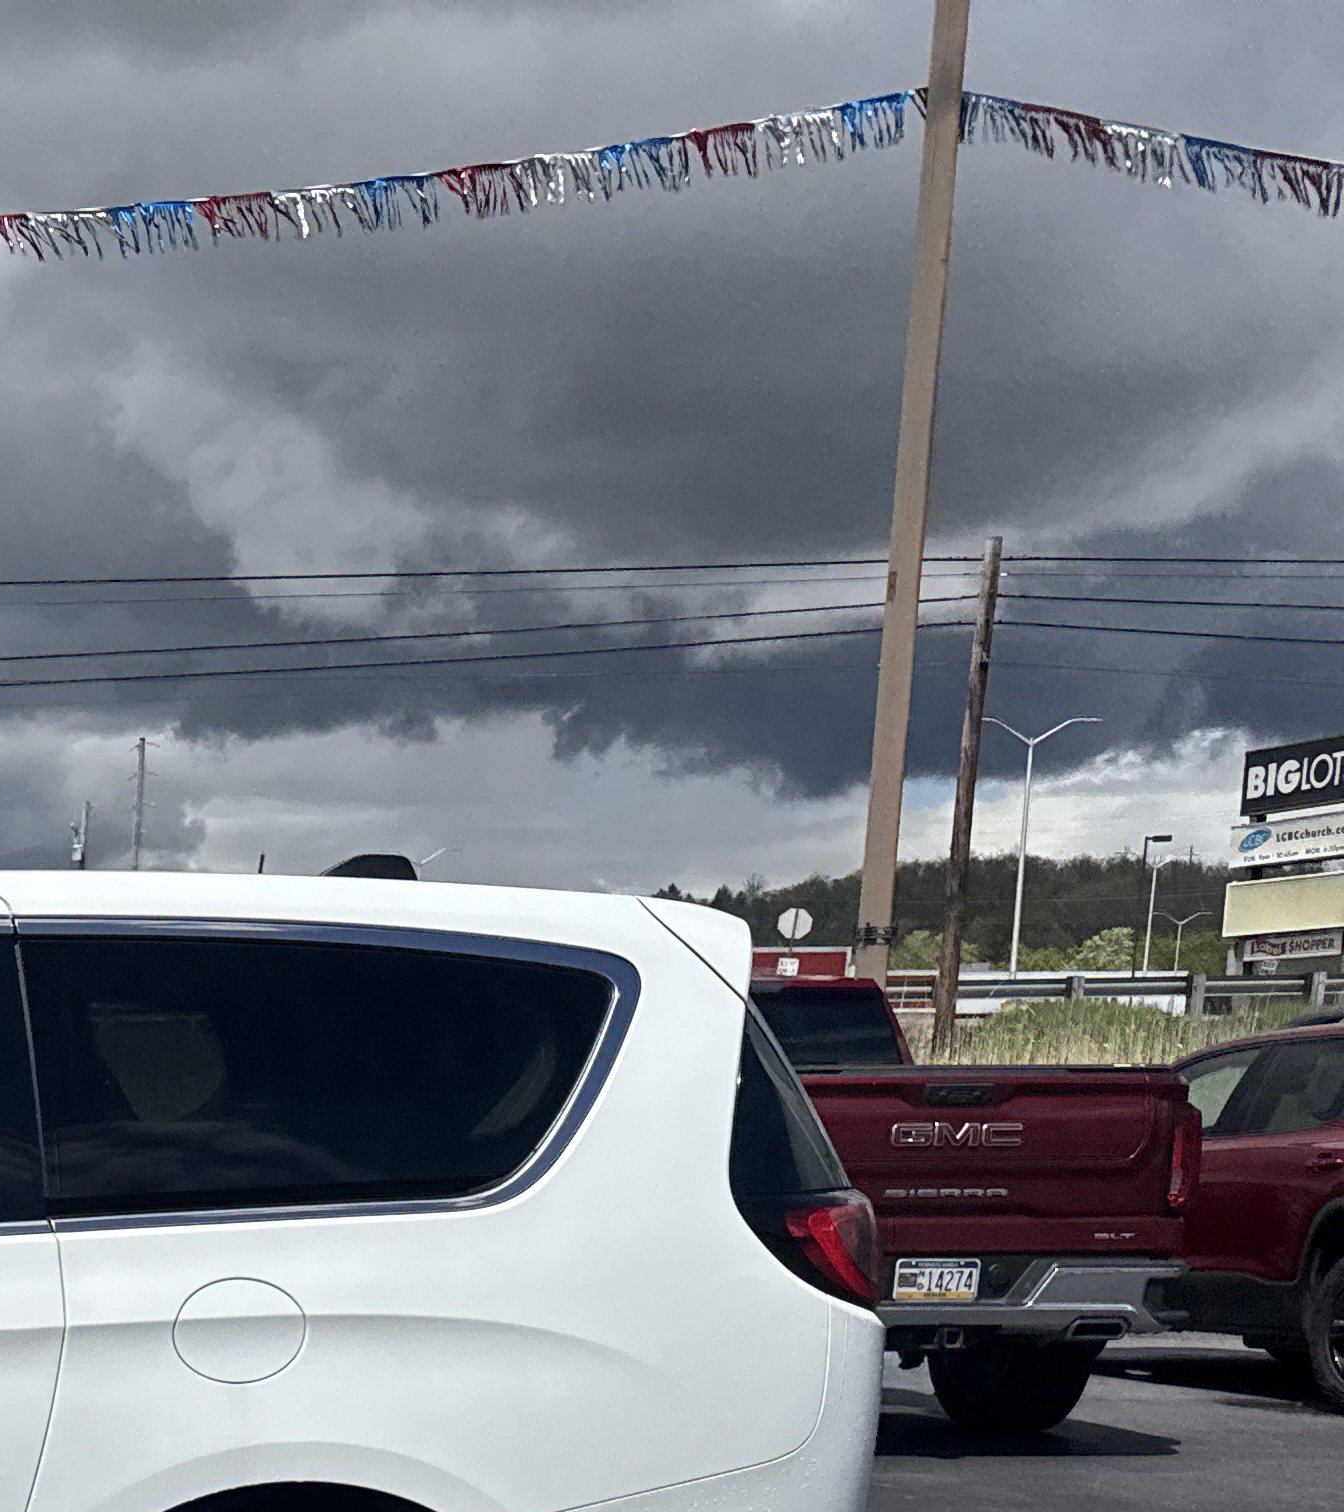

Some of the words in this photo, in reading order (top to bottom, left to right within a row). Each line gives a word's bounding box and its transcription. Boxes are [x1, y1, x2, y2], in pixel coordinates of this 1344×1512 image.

[1246, 750, 1344, 800] BIGLOT
[891, 1121, 1024, 1147] GMC
[883, 1188, 1009, 1198] SIERRA
[927, 1270, 974, 1292] 14274
